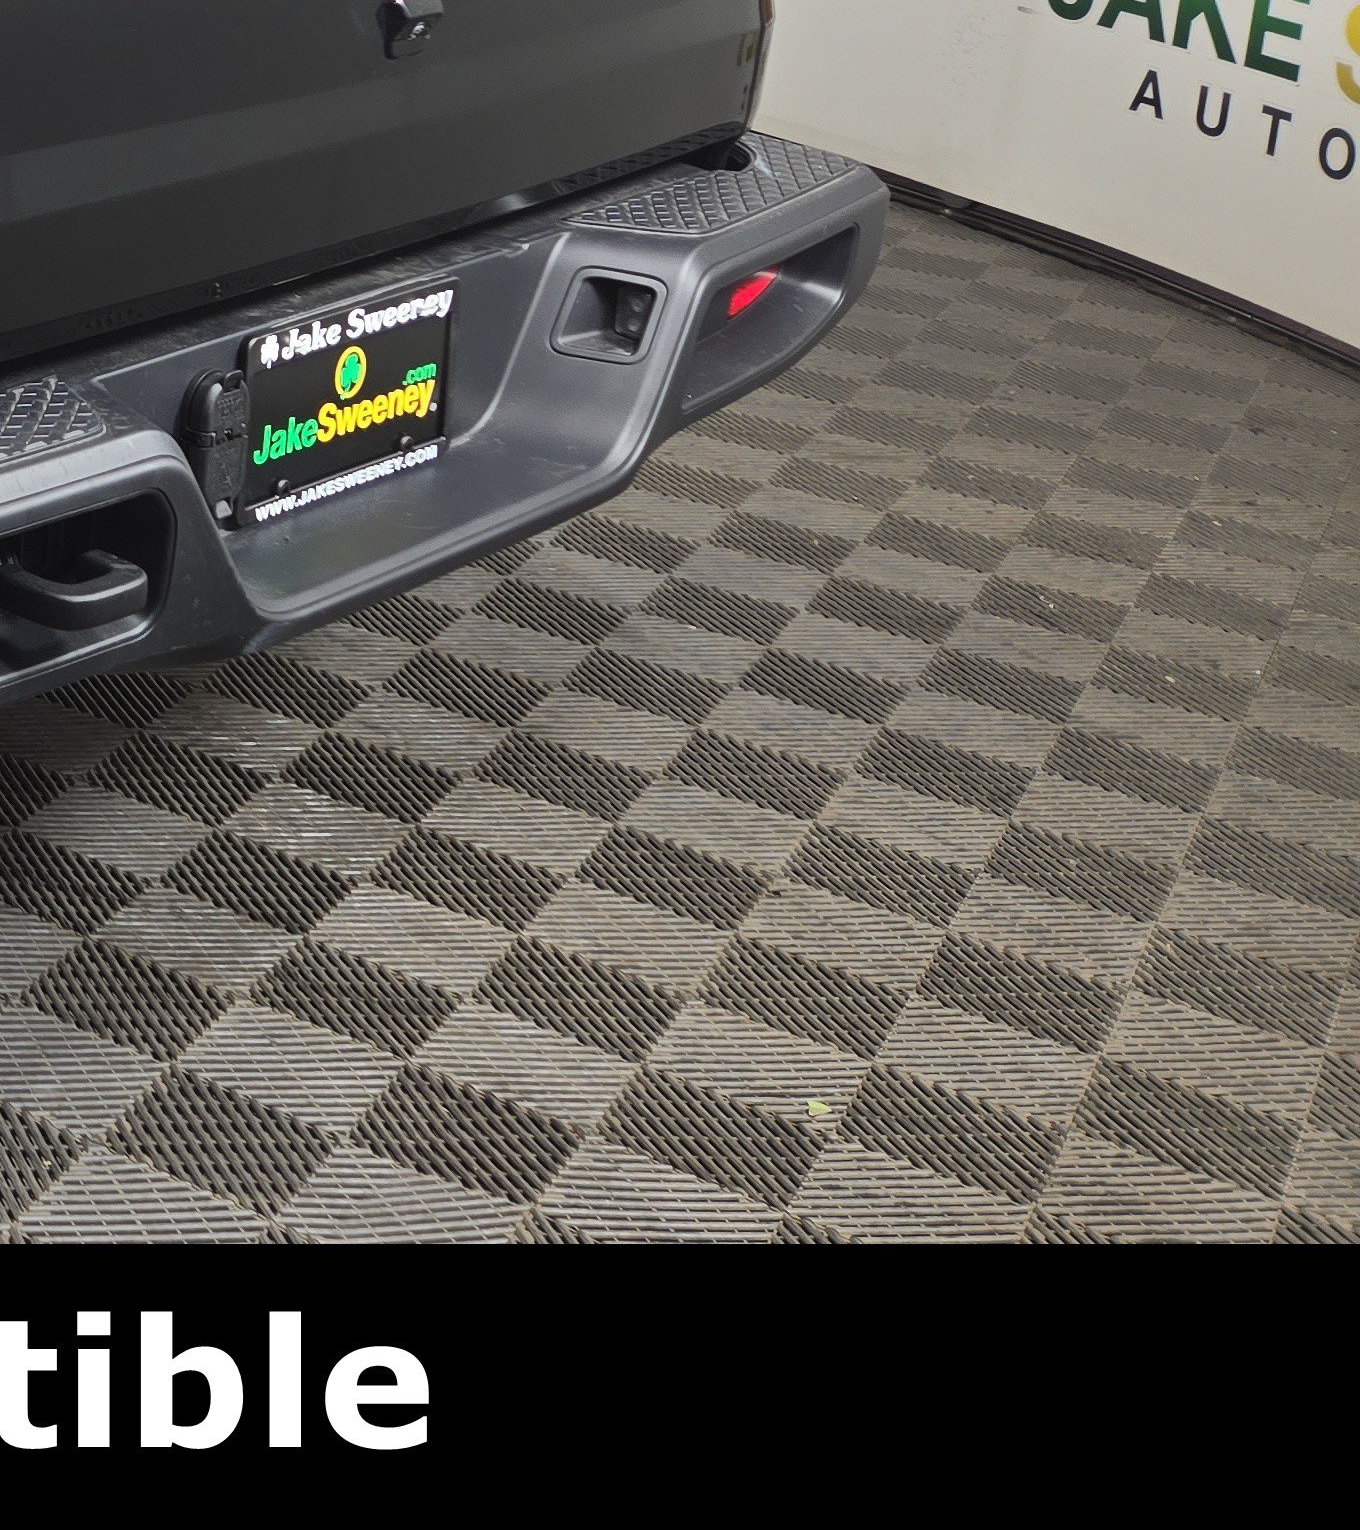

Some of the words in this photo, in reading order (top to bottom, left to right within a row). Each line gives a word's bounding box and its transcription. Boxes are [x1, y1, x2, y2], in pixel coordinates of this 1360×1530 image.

[1128, 69, 1358, 181] AUTO
[281, 321, 342, 361] Jake
[345, 289, 454, 339] Sweeney
[401, 363, 437, 386] .com
